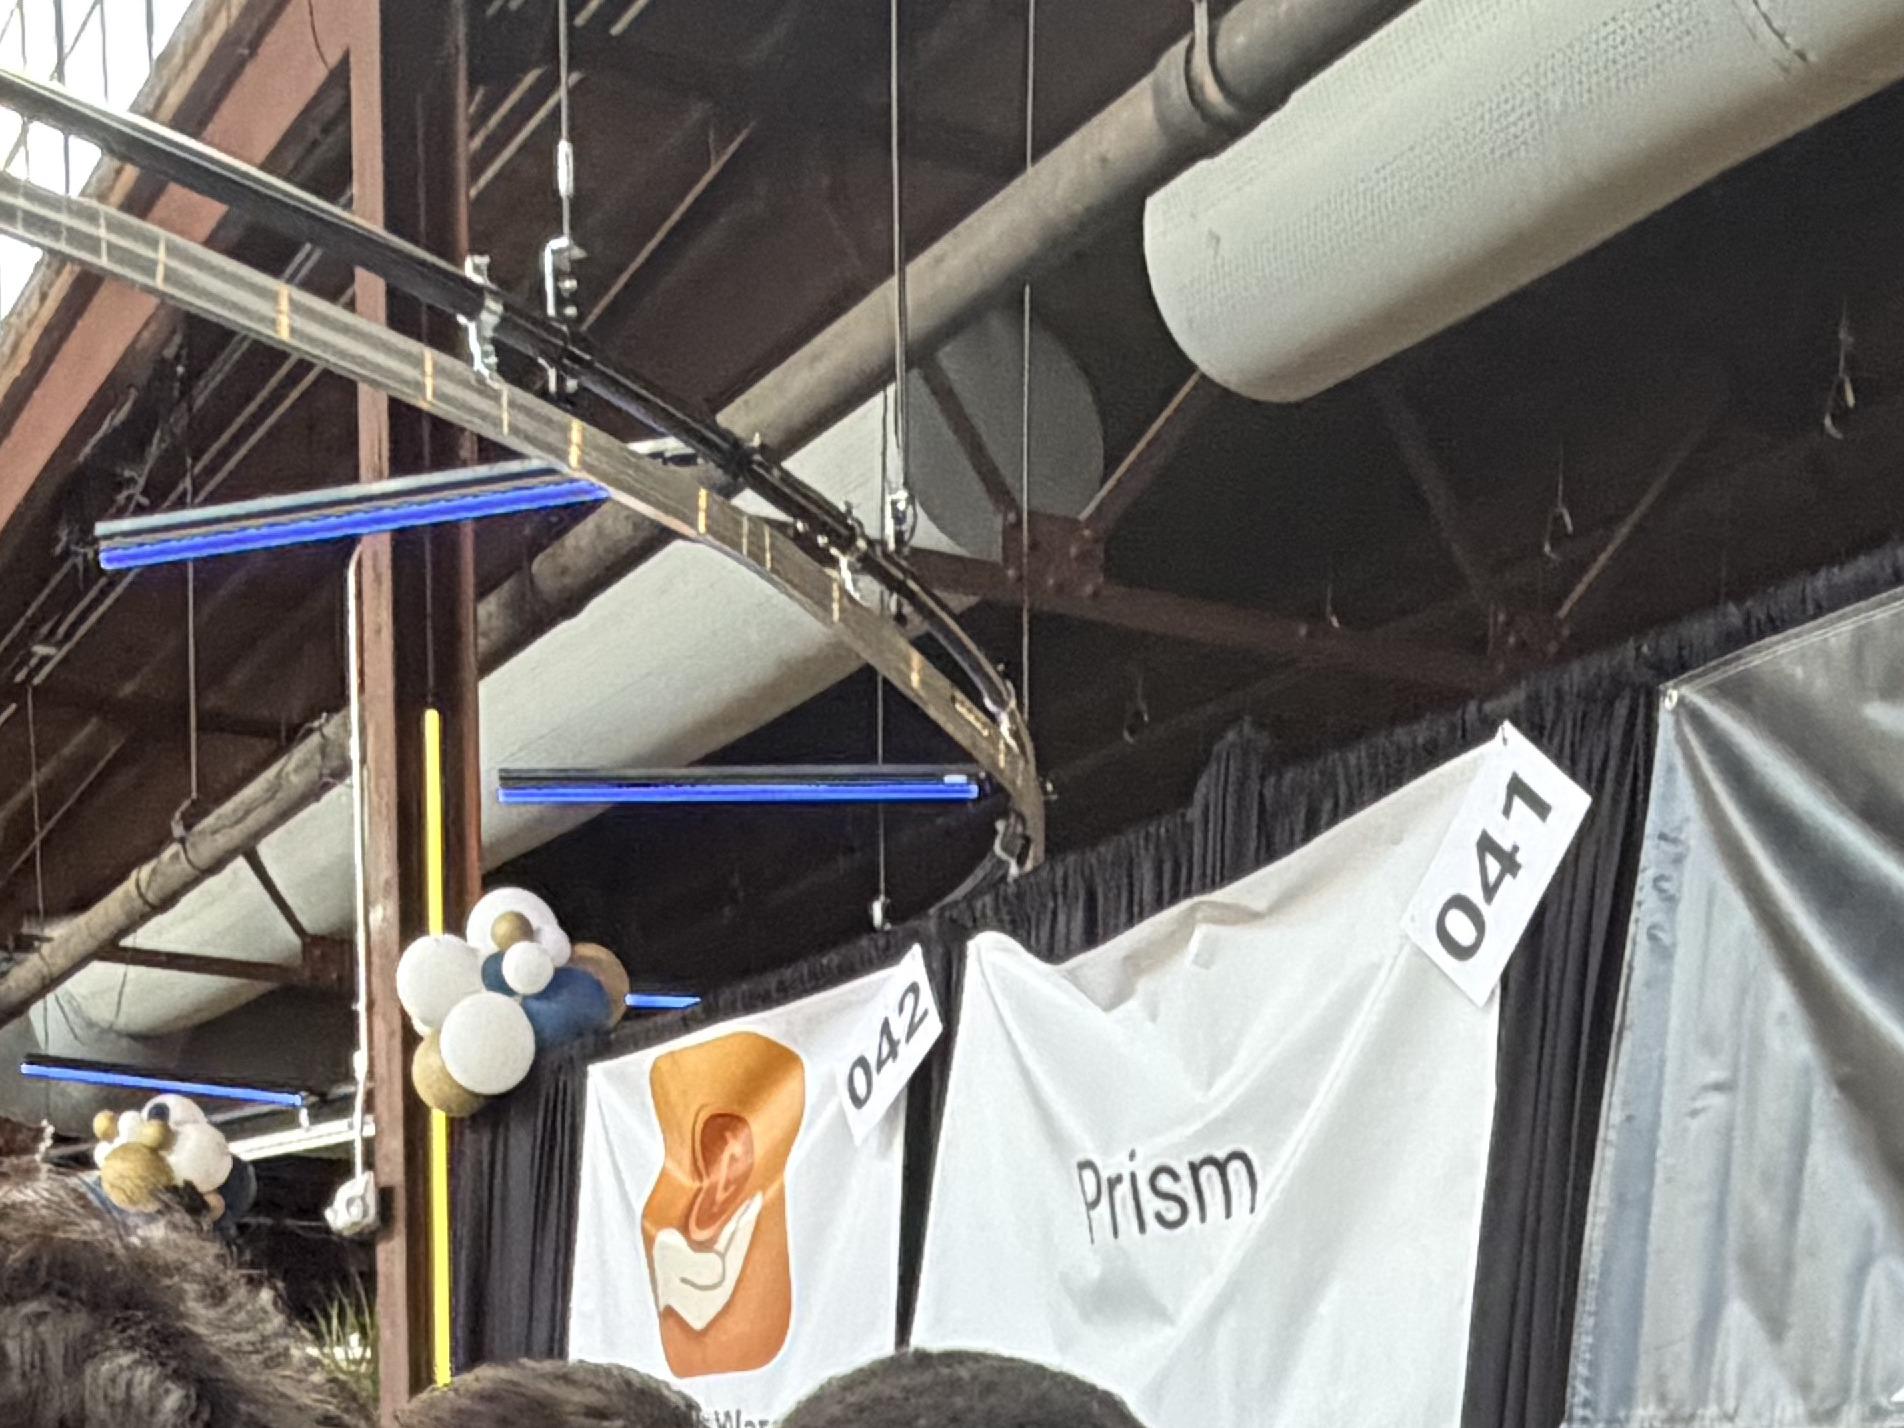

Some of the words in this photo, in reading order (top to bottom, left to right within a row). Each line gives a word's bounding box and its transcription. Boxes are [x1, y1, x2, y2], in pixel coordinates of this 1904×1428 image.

[1434, 770, 1554, 962] 041
[845, 979, 928, 1113] 042
[1077, 1145, 1260, 1245] Prism
